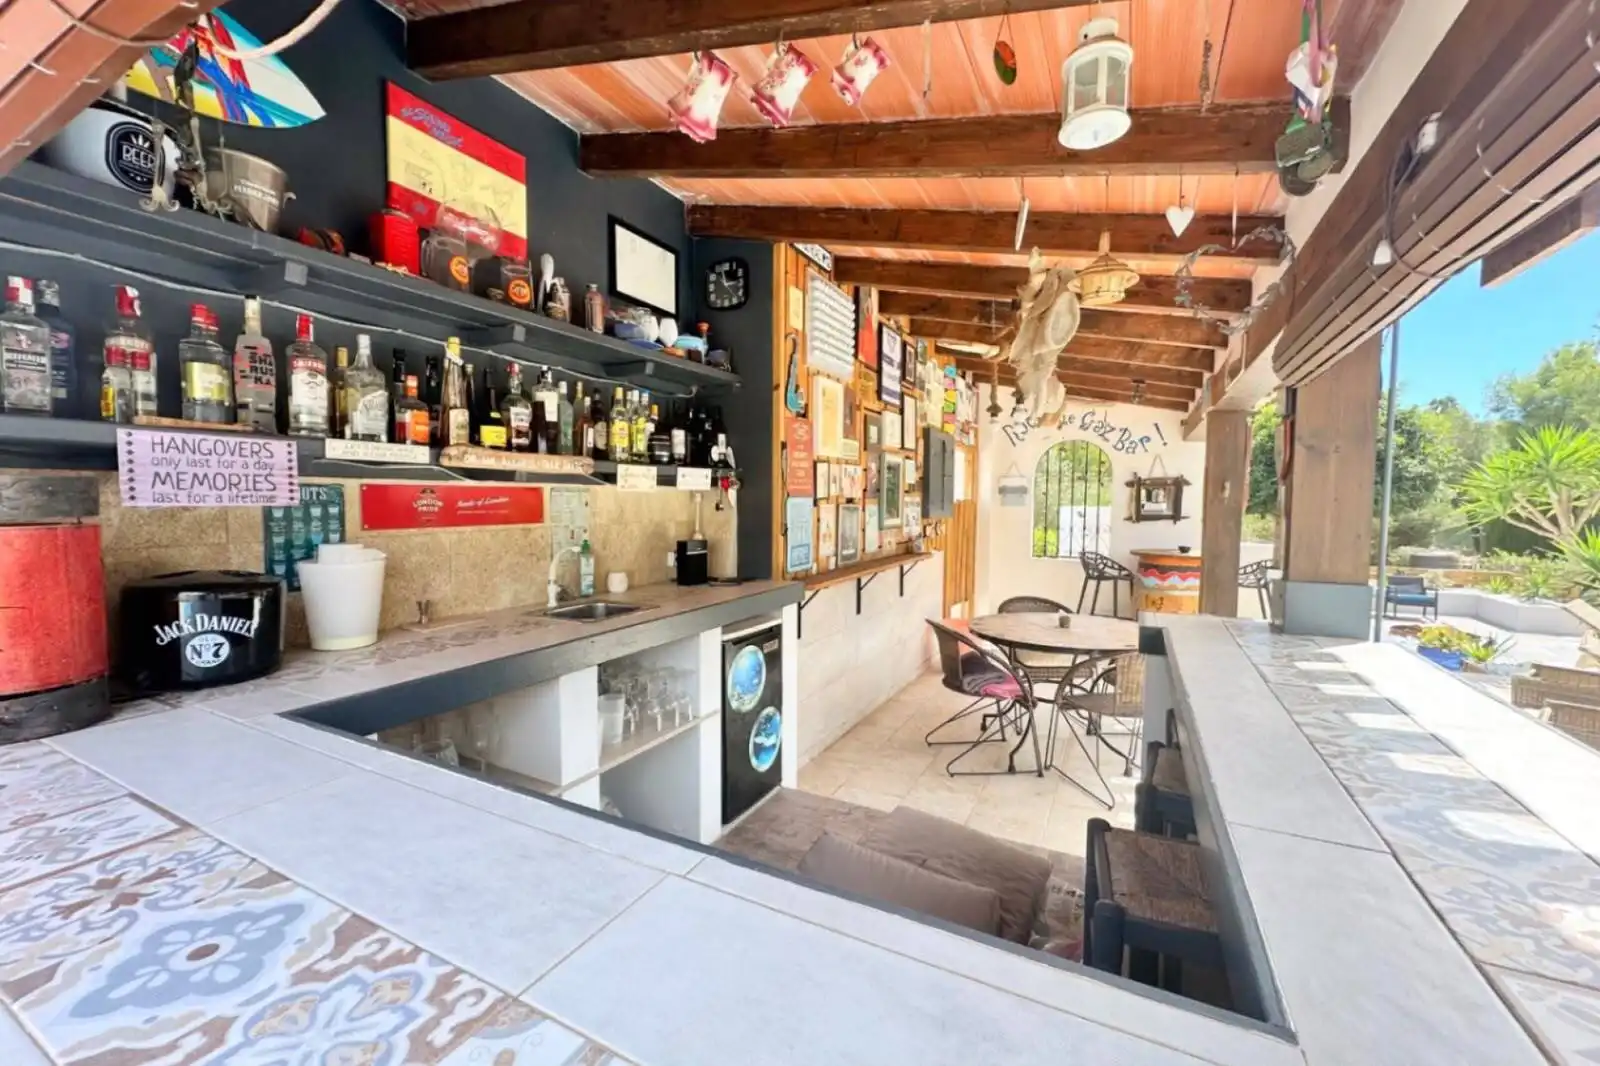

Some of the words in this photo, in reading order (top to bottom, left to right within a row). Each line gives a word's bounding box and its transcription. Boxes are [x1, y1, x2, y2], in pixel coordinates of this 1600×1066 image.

[122, 144, 157, 168] BEER
[151, 436, 274, 459] HANGOVERS
[151, 456, 181, 470] only
[186, 456, 212, 469] last
[218, 457, 237, 469] for
[241, 460, 249, 470] a
[253, 459, 275, 473] day
[151, 471, 277, 492] MEMORIES
[152, 491, 180, 504] last
[187, 491, 209, 504] for
[215, 493, 224, 504] a
[228, 493, 277, 505] lifetime
[153, 618, 195, 646] JACK
